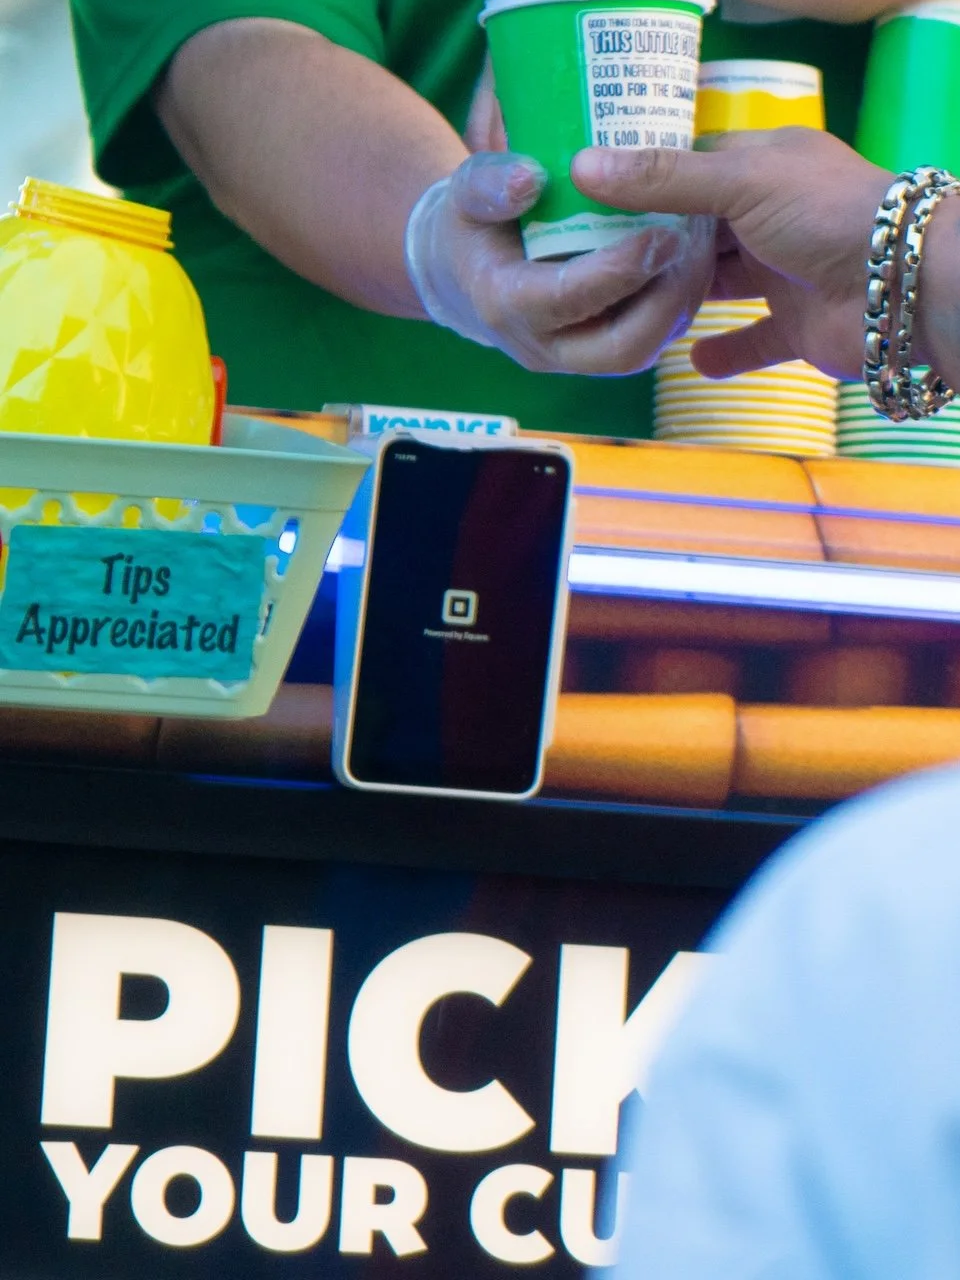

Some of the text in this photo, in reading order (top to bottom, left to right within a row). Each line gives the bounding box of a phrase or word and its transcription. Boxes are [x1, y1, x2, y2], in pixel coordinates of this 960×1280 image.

[589, 30, 632, 55] THIS
[634, 30, 680, 55] LITTLE
[592, 64, 619, 79] GOOD
[593, 83, 623, 98] GOOD
[627, 82, 647, 97] FOR
[652, 83, 669, 98] THE
[617, 105, 646, 116] MILLION
[100, 553, 171, 604] Tips
[16, 603, 239, 654] Appreciated
[40, 911, 722, 1156] PICK
[40, 1141, 428, 1257] YOUR
